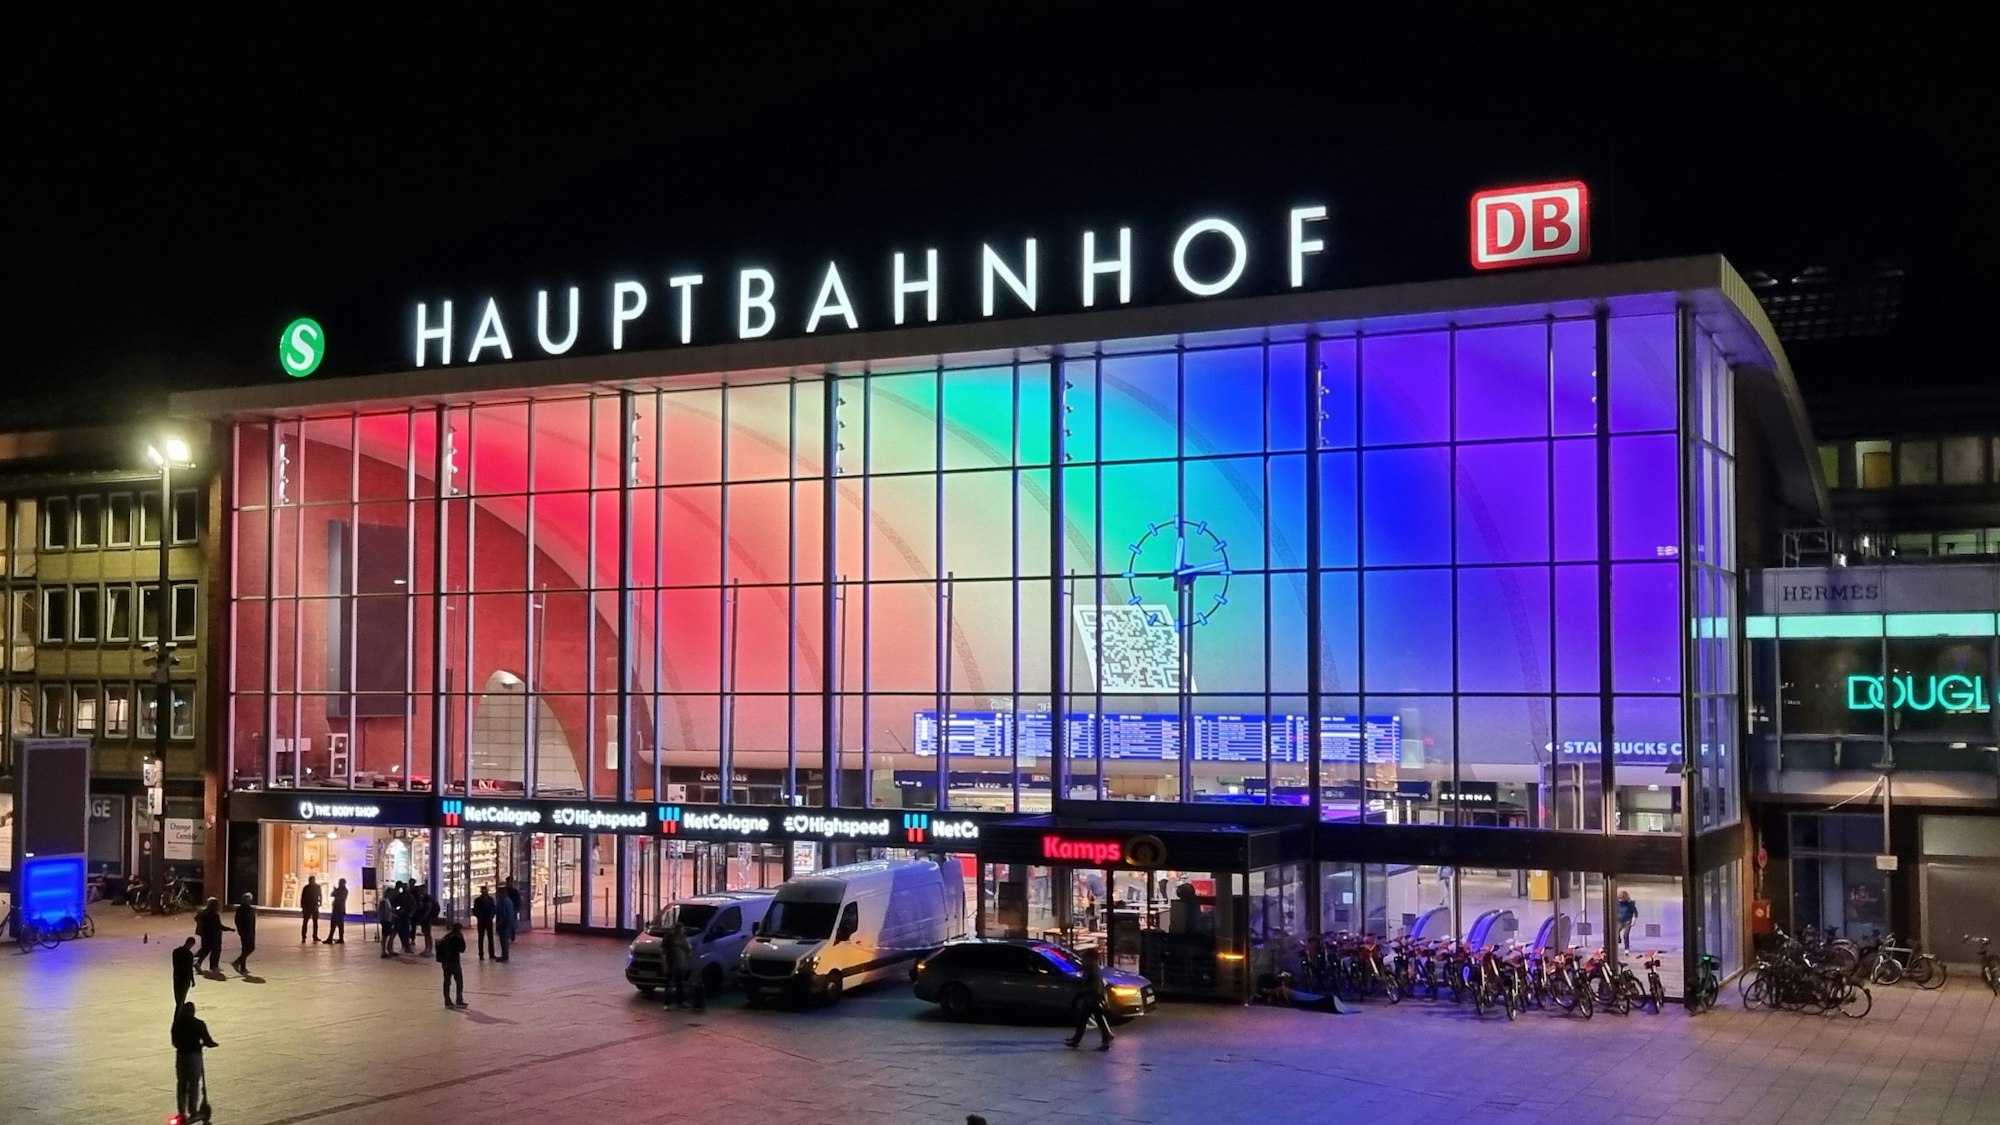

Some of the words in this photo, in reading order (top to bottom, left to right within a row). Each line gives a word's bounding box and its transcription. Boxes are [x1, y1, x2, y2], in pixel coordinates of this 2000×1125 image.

[1485, 196, 1572, 256] DB
[415, 206, 1328, 367] HAUPTBAHNHOF
[286, 323, 318, 371] S
[1847, 673, 2000, 711] DOUGL
[314, 804, 332, 817] THE
[332, 805, 355, 818] BODY
[355, 806, 380, 818] SHOP
[464, 806, 542, 826] NetCologne
[575, 809, 648, 829] Highspeed
[683, 812, 770, 834] NetCologne
[808, 816, 891, 838] Highspeed
[1043, 836, 1121, 865] Kamps
